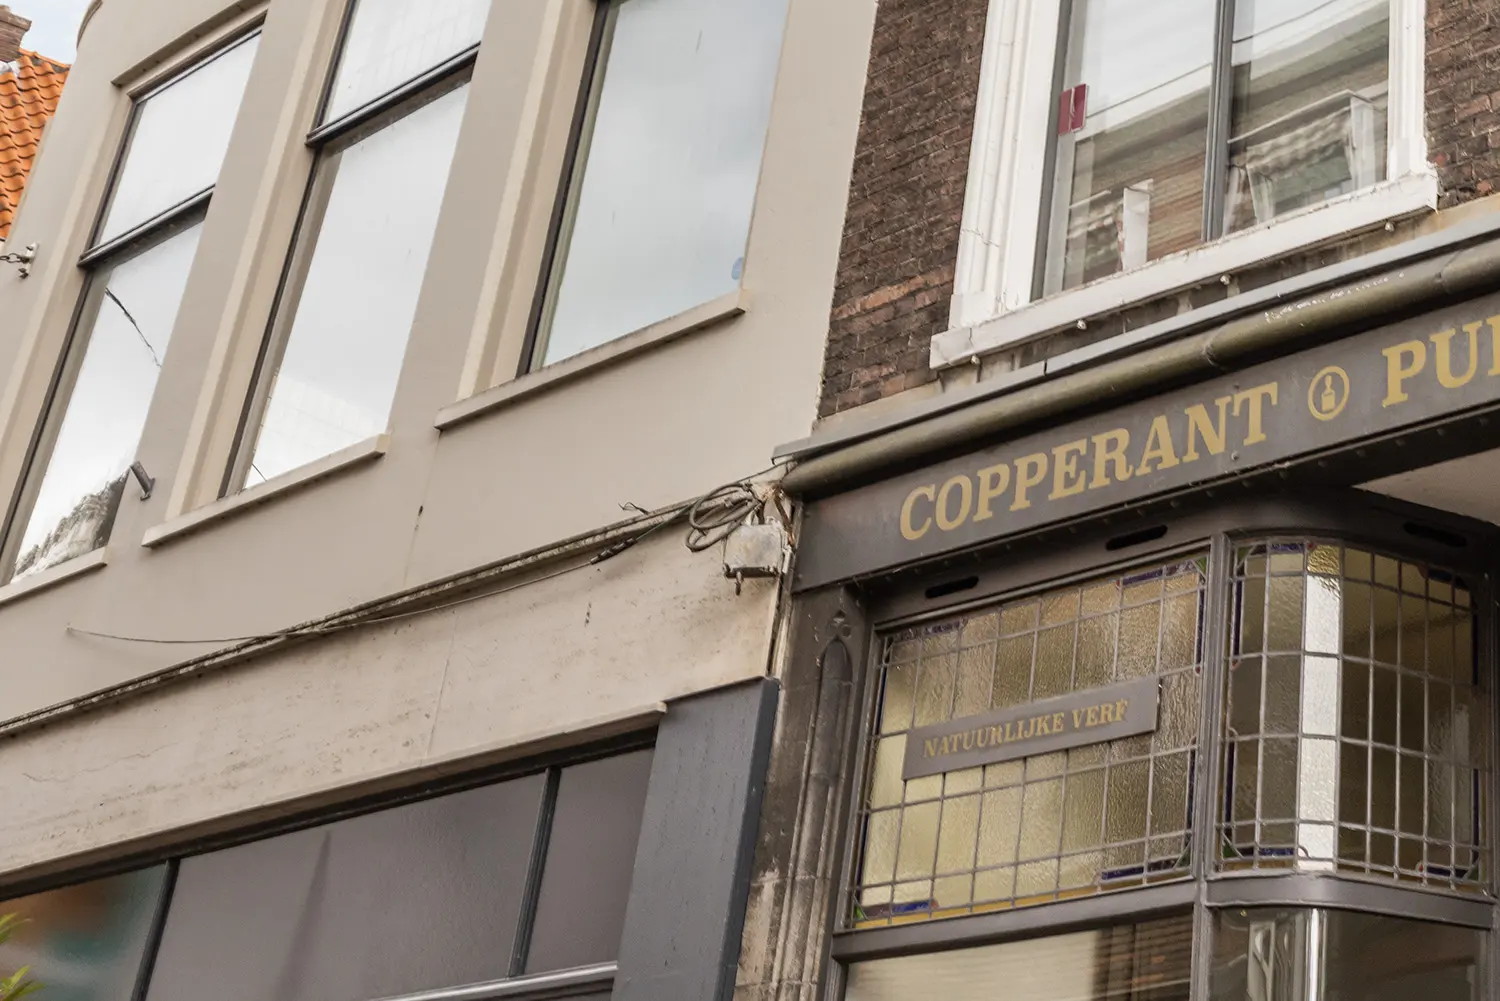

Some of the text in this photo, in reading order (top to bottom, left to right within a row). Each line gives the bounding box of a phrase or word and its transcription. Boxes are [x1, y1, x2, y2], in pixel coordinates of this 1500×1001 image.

[900, 382, 1278, 541] COPPERANT
[923, 699, 1128, 758] NATUURLIJKE VERF
